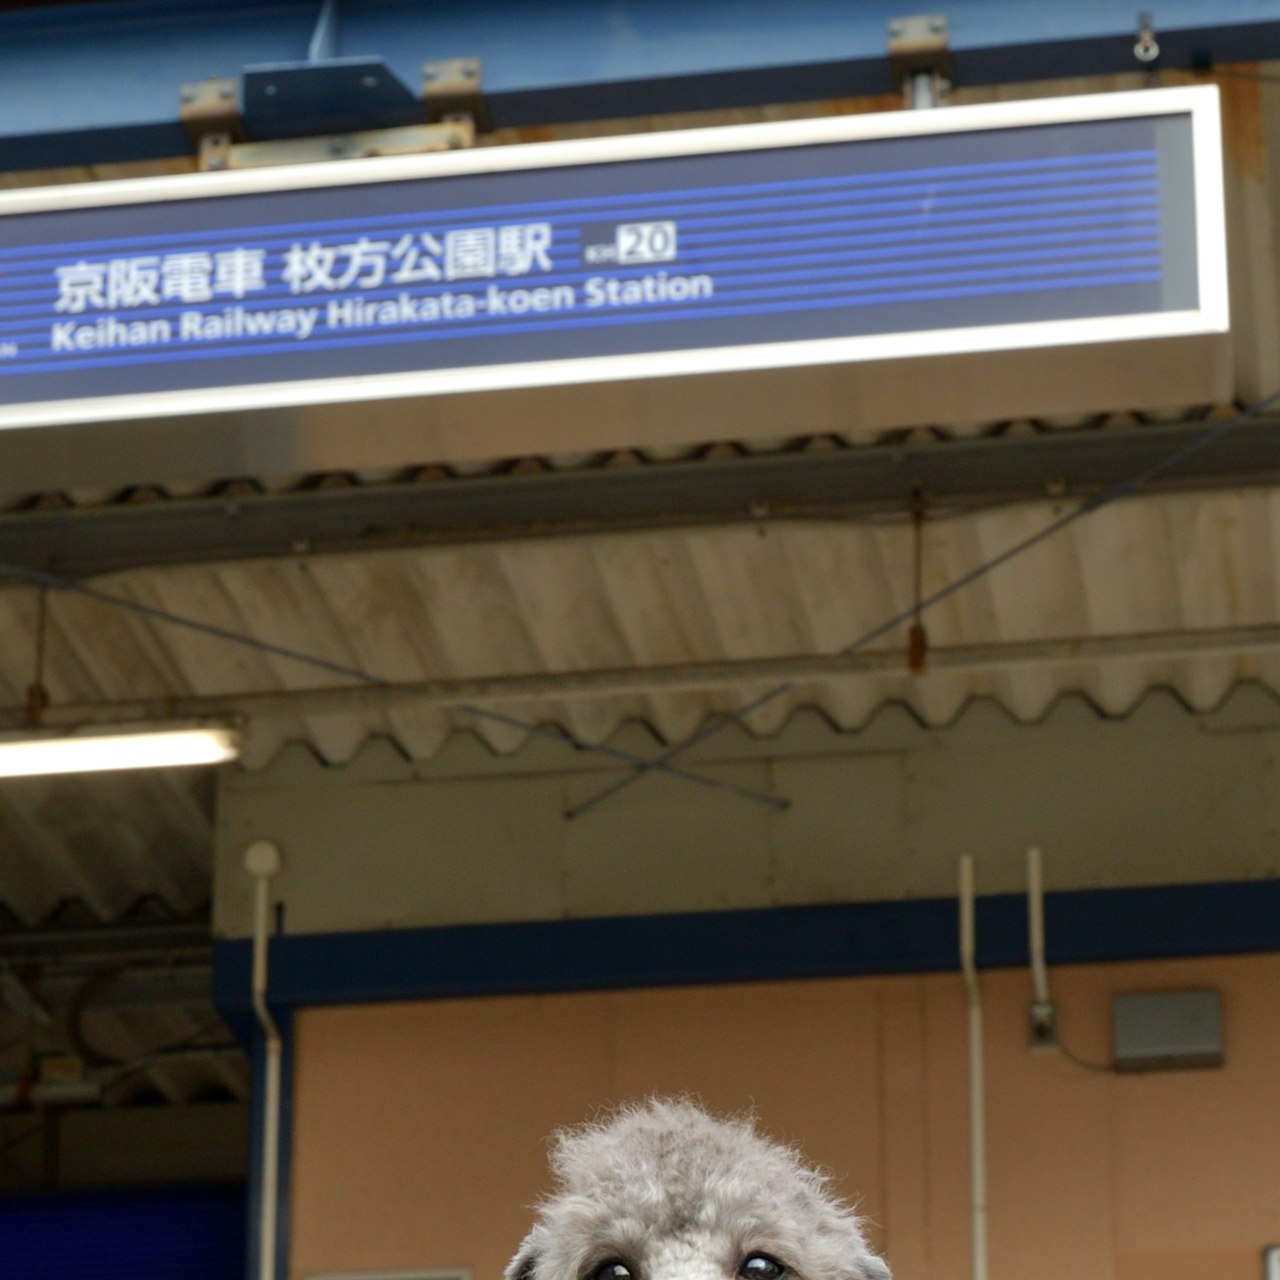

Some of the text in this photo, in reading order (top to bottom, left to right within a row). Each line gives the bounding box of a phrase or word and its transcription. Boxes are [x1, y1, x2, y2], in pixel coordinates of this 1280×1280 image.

[54, 222, 553, 312] 京阪電車 枚方公園駅
[623, 225, 671, 258] 20
[51, 271, 713, 351] Keihan Railway Hirakata-koen Station
